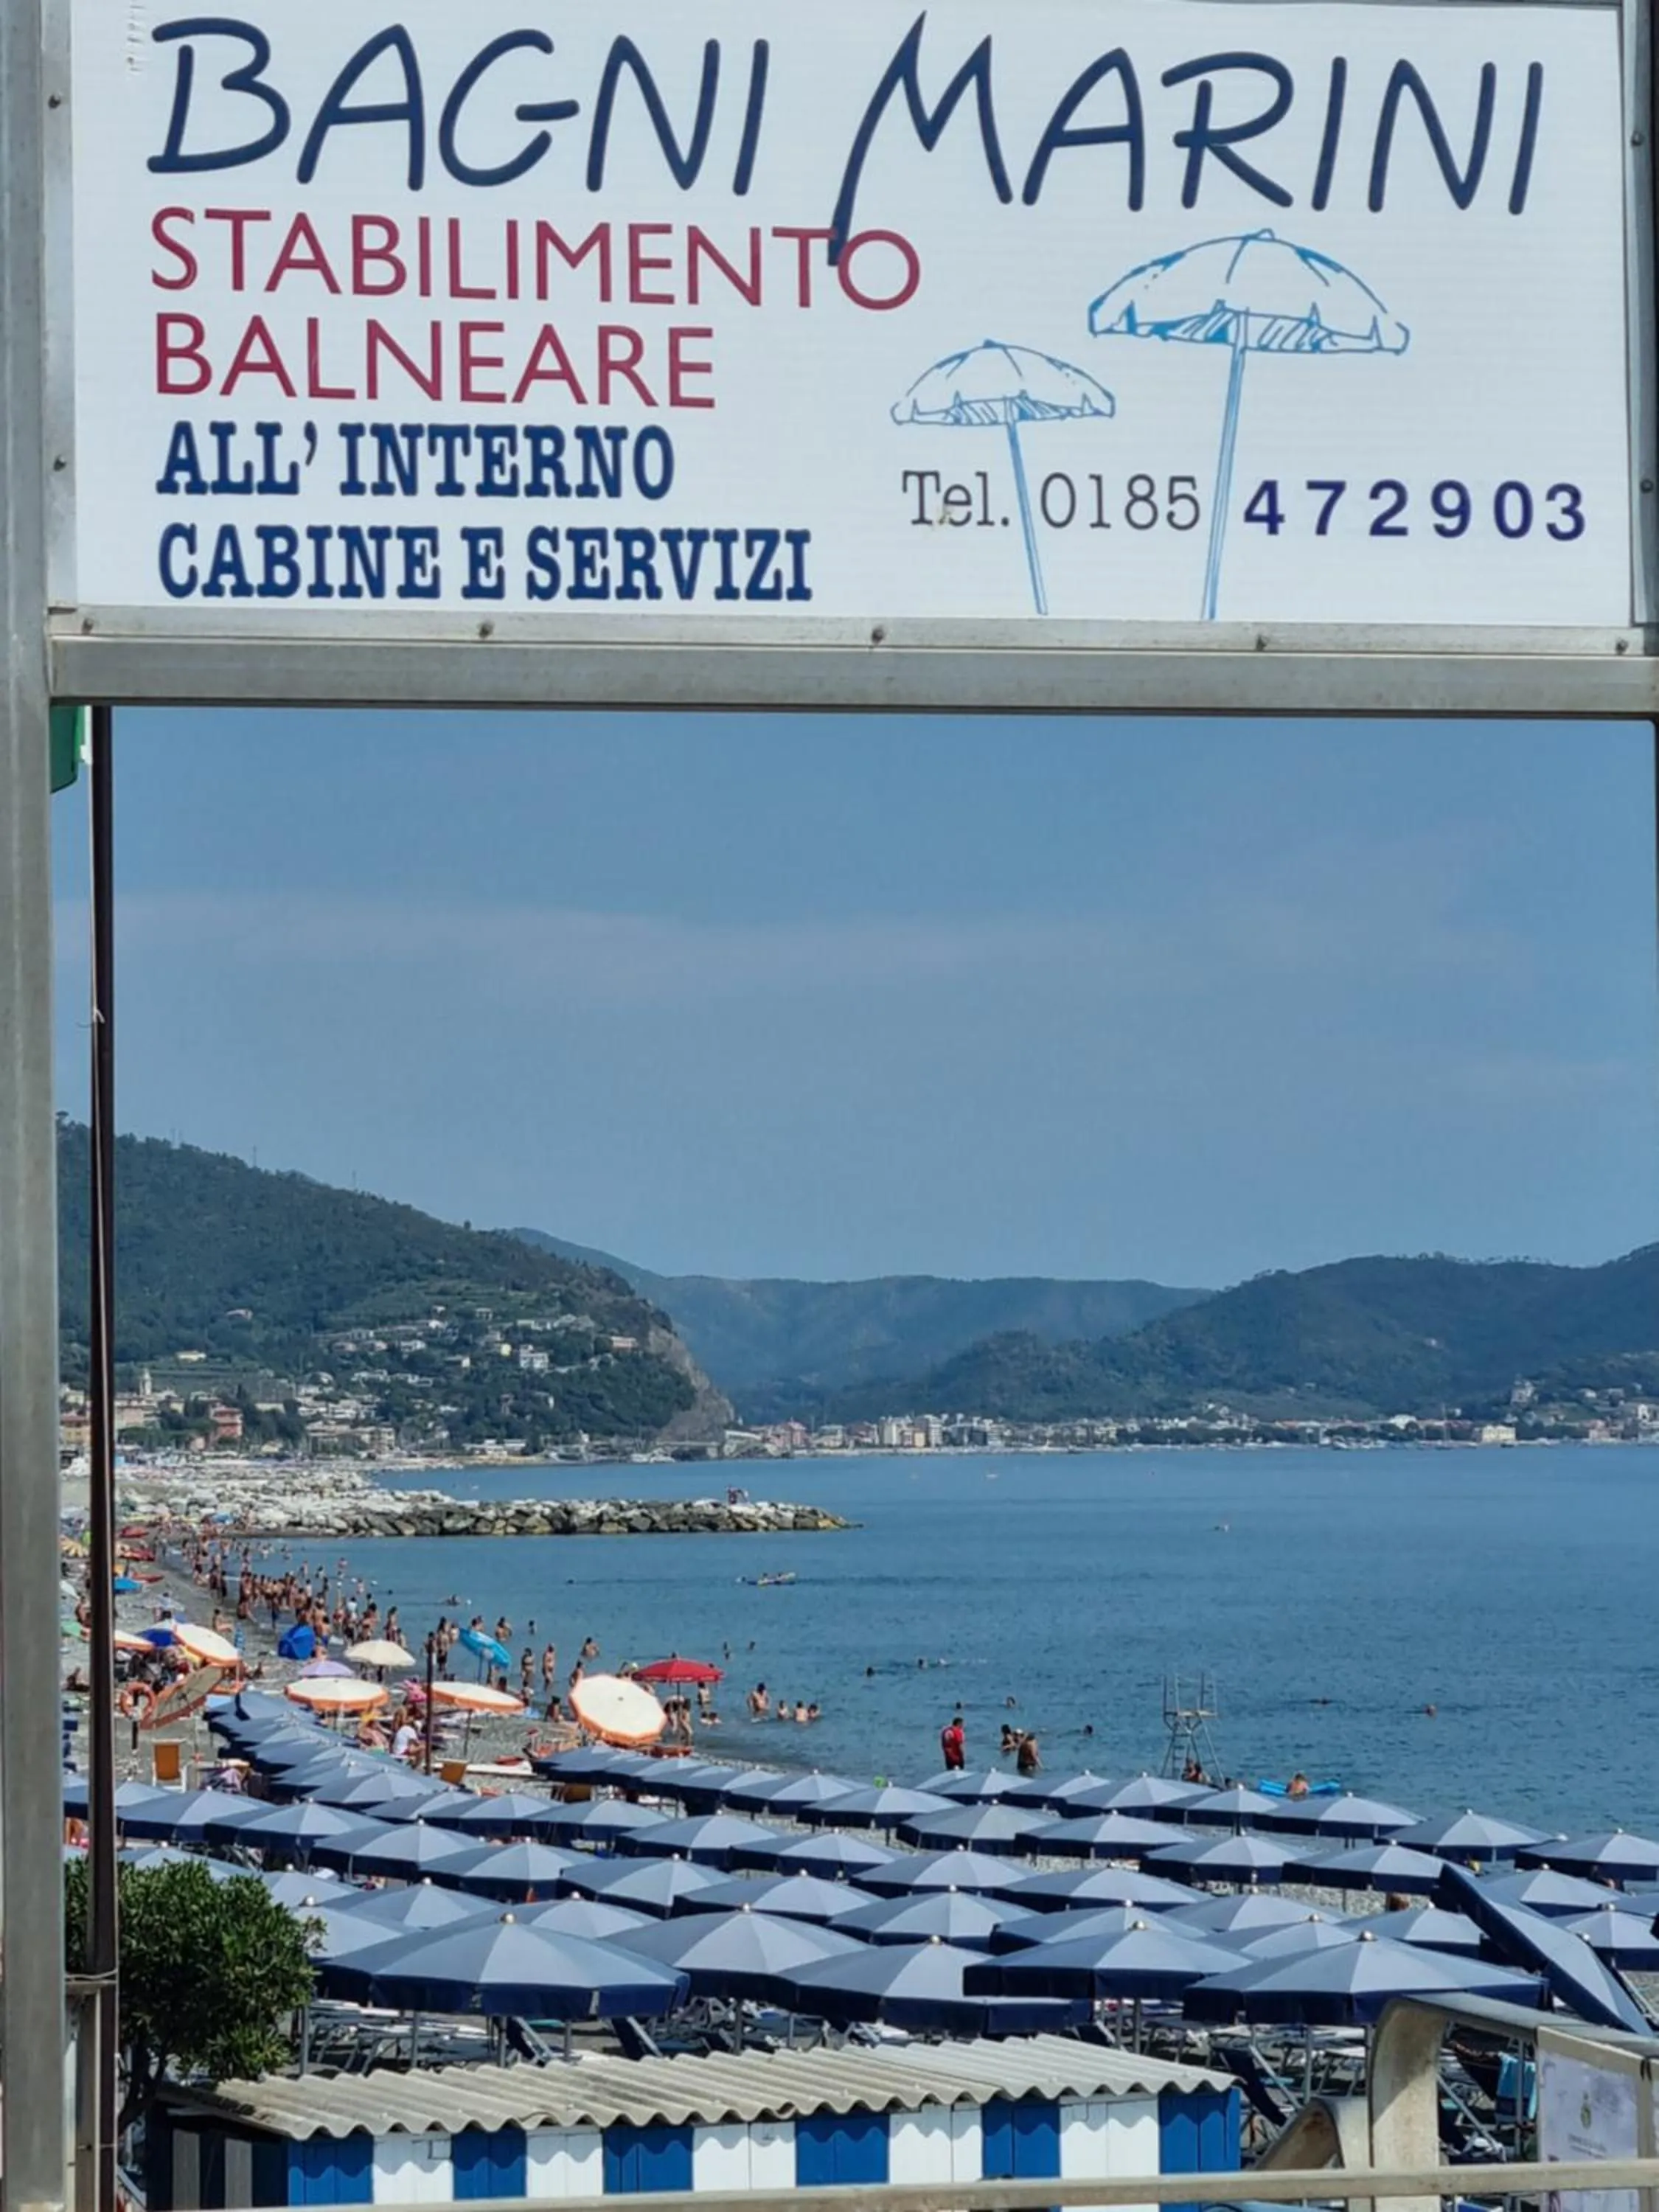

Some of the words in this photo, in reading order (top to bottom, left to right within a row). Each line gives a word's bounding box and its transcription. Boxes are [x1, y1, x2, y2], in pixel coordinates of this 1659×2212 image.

[147, 18, 769, 196] BAGNI
[827, 11, 1543, 265] MARINI
[151, 206, 921, 310] STABILIMENTO
[156, 313, 715, 409] BALNEARE
[902, 470, 1011, 529] Tel.
[1040, 472, 1200, 531] 0185
[1243, 479, 1585, 542] 472903
[158, 522, 441, 599] CABINE
[459, 526, 506, 600] E
[526, 526, 813, 602] SERVIZI
